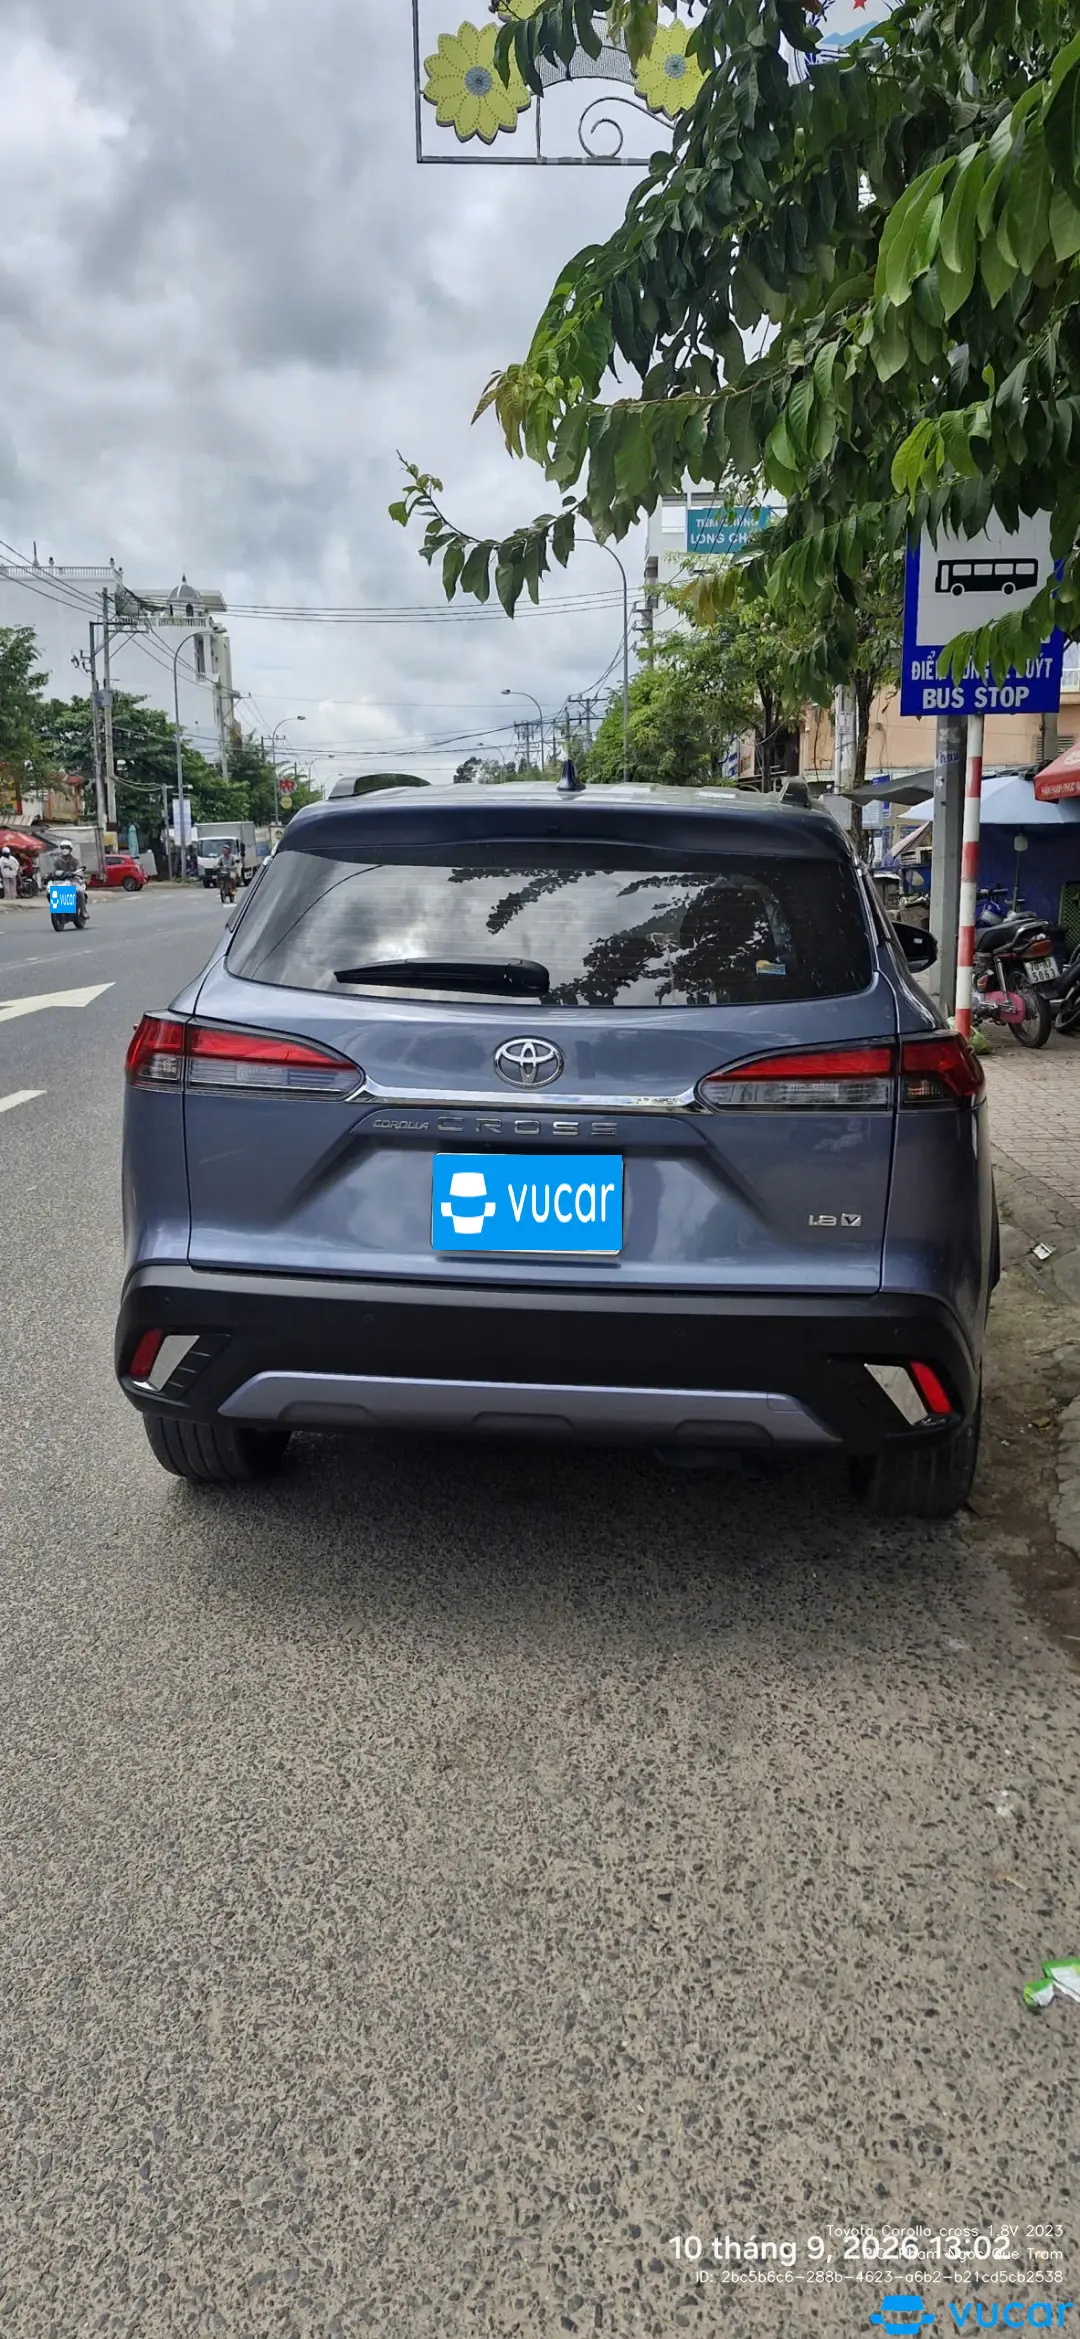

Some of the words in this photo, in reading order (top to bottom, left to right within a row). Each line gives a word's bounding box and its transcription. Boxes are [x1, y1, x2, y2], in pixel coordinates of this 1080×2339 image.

[690, 533, 725, 544] LONG
[728, 532, 751, 544] CH
[922, 687, 965, 709] BUS
[974, 686, 1029, 708] STOP
[373, 1119, 429, 1131] COROLLA
[437, 1116, 617, 1136] CROSS
[808, 1214, 837, 1226] 1.8
